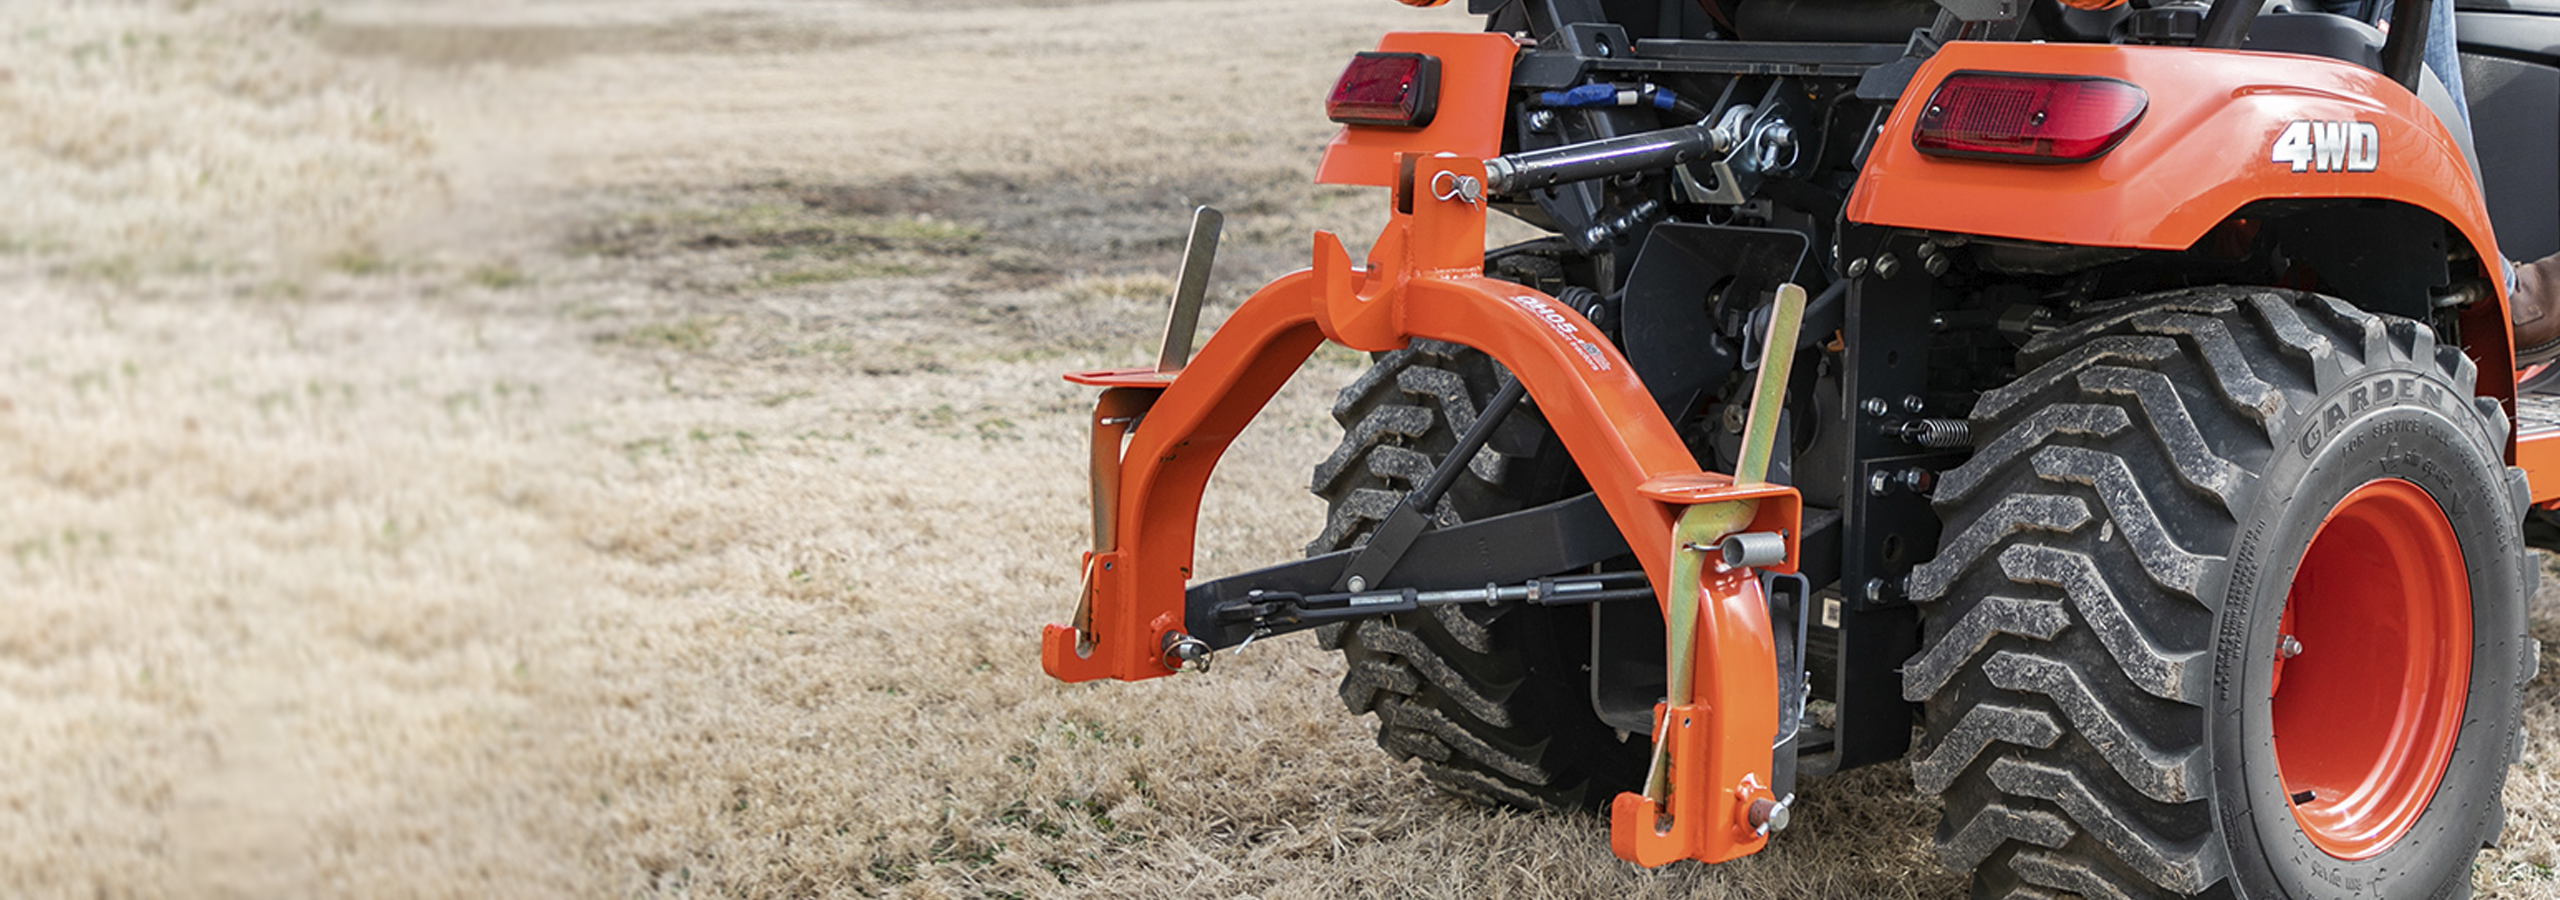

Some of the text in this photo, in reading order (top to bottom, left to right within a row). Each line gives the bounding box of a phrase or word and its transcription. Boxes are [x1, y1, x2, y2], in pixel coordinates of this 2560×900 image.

[2271, 119, 2379, 173] 4WD
[2299, 378, 2443, 460] GARDEN
[2341, 433, 2365, 458] FOR
[2372, 418, 2420, 439] SERVICE
